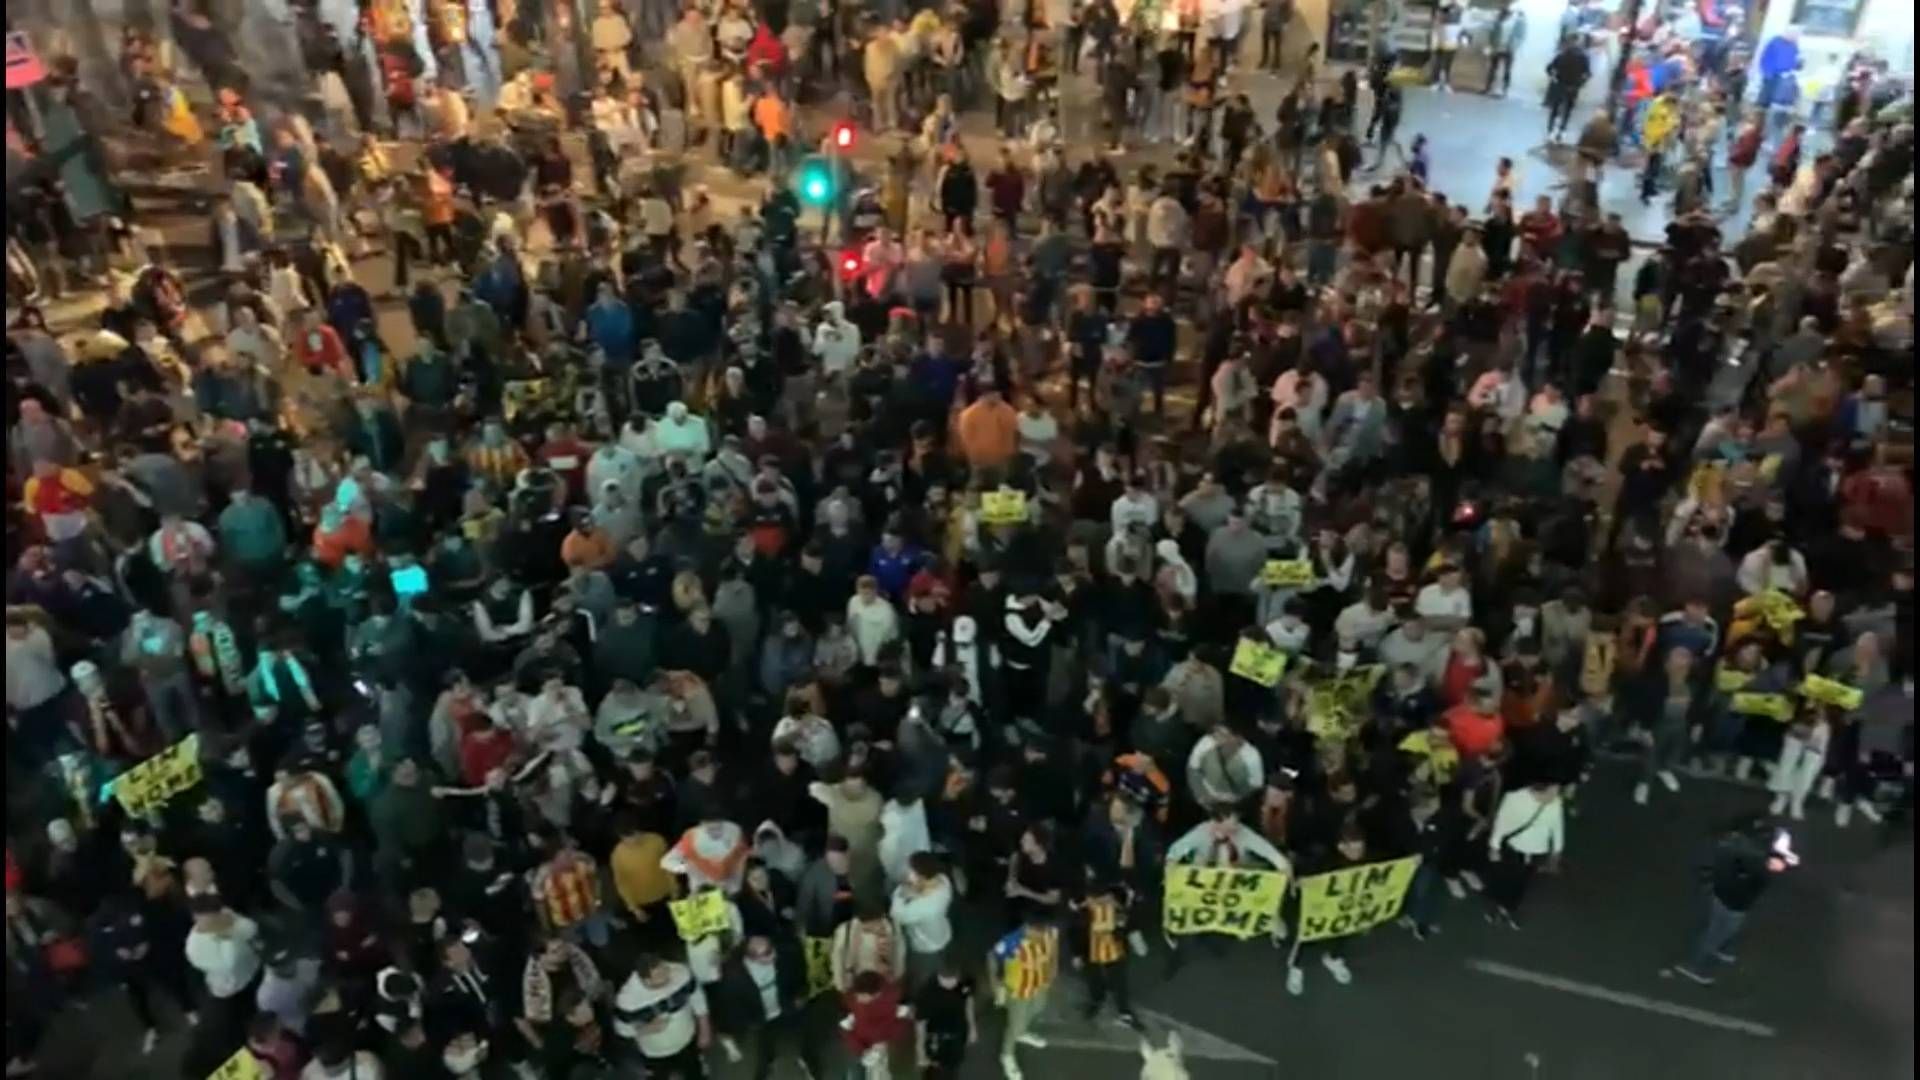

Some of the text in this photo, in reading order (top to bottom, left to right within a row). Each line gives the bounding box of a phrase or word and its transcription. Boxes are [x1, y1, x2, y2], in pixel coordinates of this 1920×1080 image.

[1185, 869, 1261, 892] LIM
[1326, 864, 1394, 896] LIM
[1201, 892, 1241, 907] GO
[1168, 907, 1272, 932] HOME
